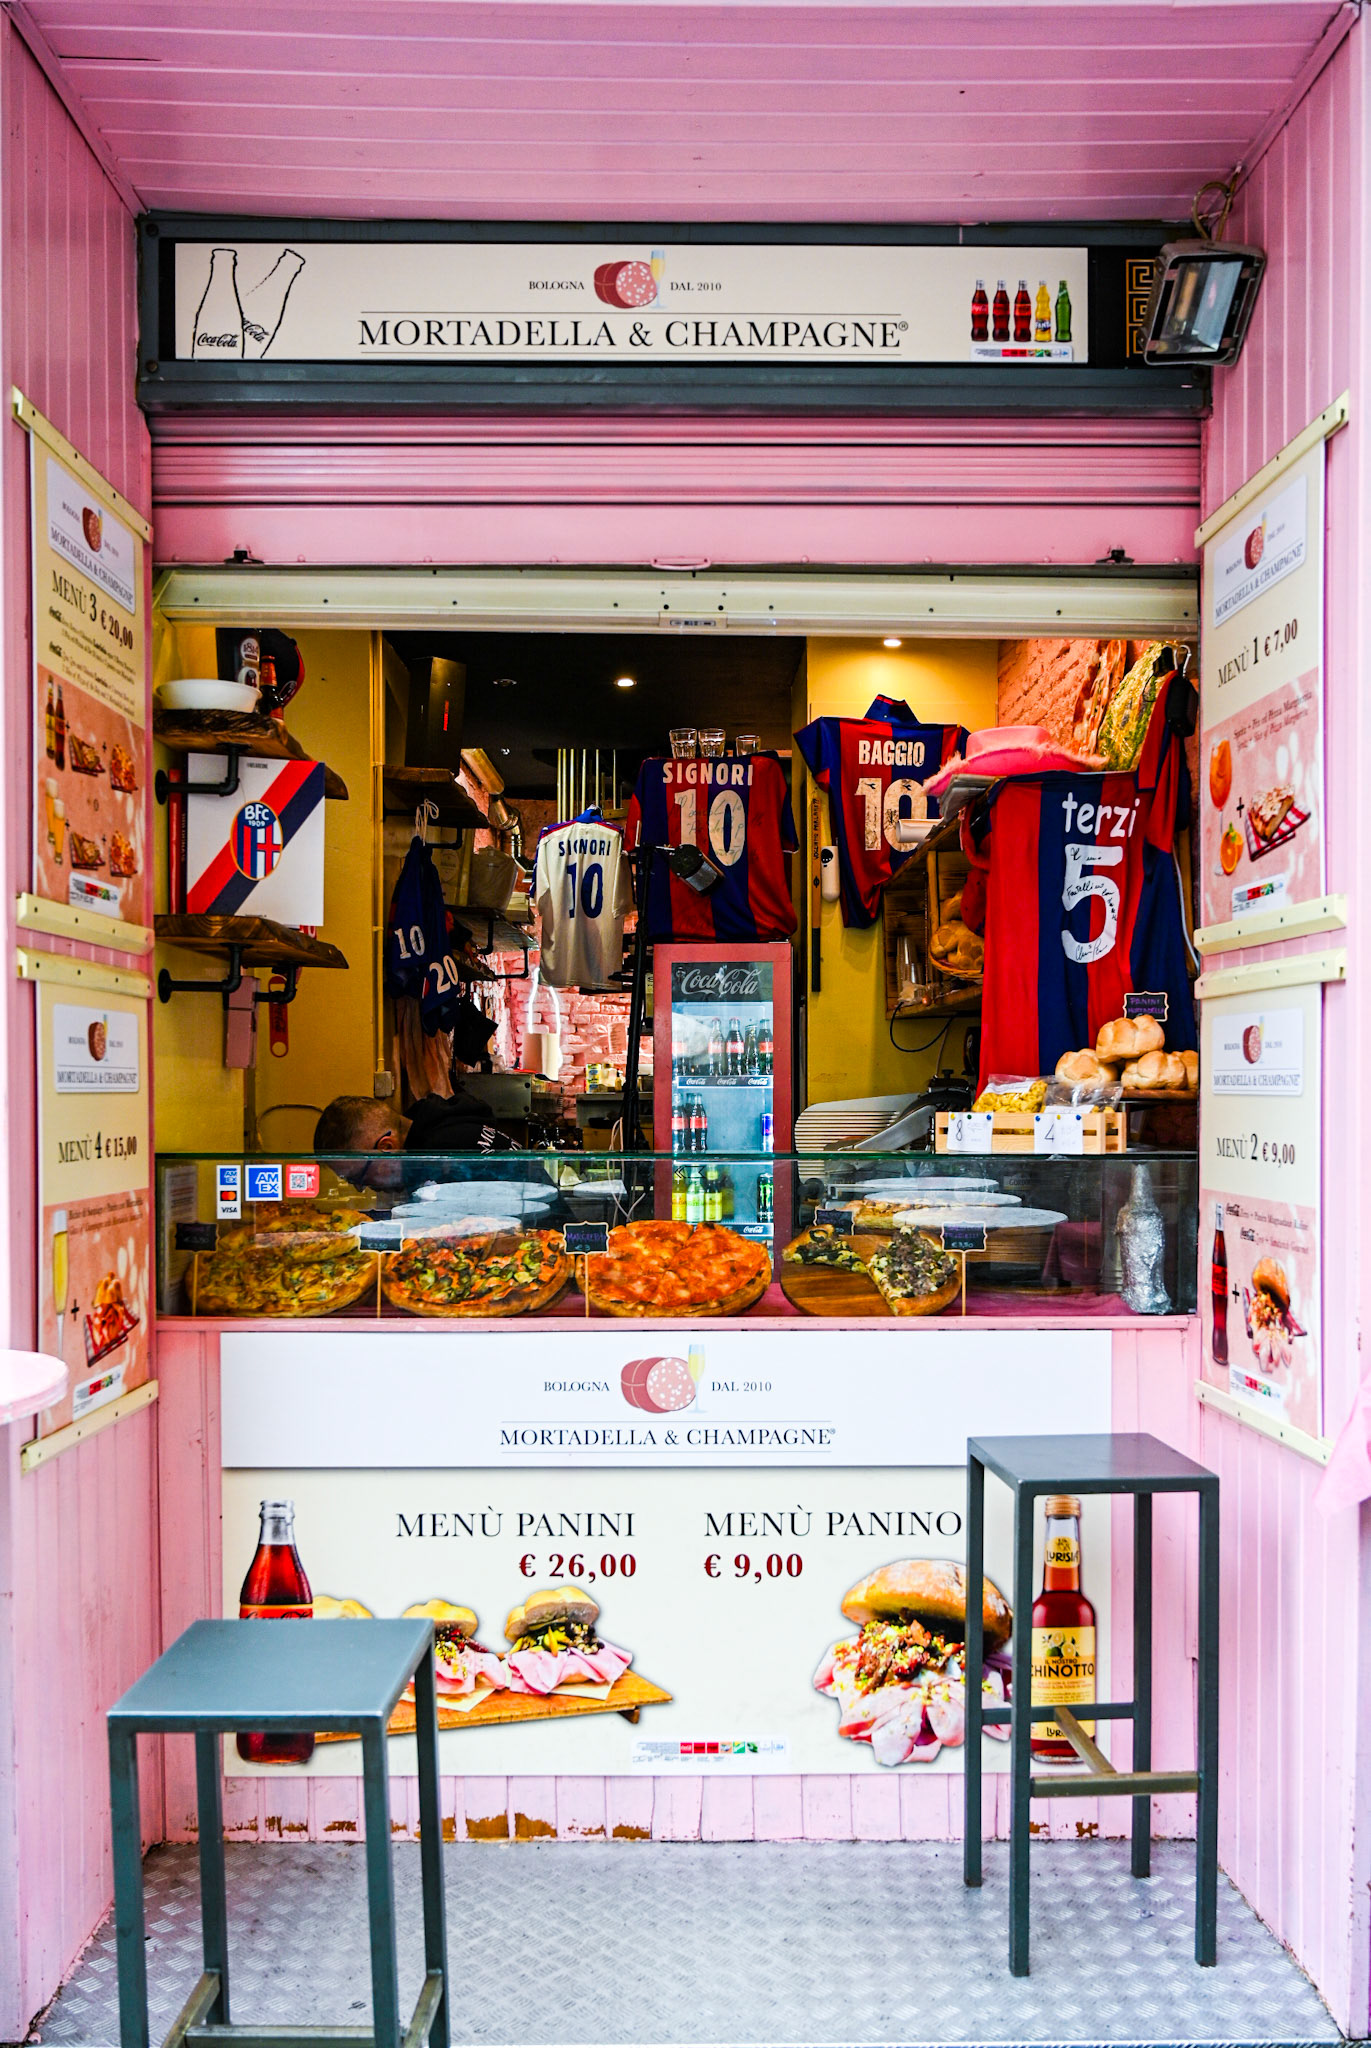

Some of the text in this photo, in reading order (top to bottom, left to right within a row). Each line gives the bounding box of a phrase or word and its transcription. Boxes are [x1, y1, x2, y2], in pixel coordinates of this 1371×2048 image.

[529, 281, 584, 289] BOLOGNA
[670, 282, 722, 291] DAL 2010
[358, 320, 616, 346] MORTADELLA
[630, 321, 652, 346] &
[50, 526, 92, 570] MORTADELLA
[52, 569, 87, 615] MENÙ
[90, 593, 97, 621] 3
[101, 609, 106, 630] €
[108, 615, 133, 650] 20,00
[1215, 583, 1254, 619] MORTADELLA
[1218, 618, 1298, 688] MENÙ 1 € 7,00
[858, 740, 926, 767] BAGGIO
[662, 762, 752, 786] SIGNORI
[245, 804, 270, 820] BFC
[854, 777, 928, 852] 10
[1062, 791, 1140, 838] terzi
[674, 789, 746, 866] 10
[559, 839, 611, 856] SIGNORI
[567, 862, 604, 918] 10
[1061, 843, 1123, 963] 5
[394, 925, 426, 960] 10
[429, 955, 459, 994] 20
[57, 1071, 98, 1084] MORTADELLA
[1214, 1074, 1252, 1086] MORTADELLA
[58, 1131, 137, 1163] MENÙ 4 € 15,00
[1044, 1123, 1055, 1142] 4
[1216, 1133, 1295, 1168] MENÙ 2 € 9,00
[257, 1174, 278, 1182] AM
[260, 1184, 278, 1192] EX
[545, 1382, 609, 1391] BOLOGNA
[712, 1382, 772, 1392] DAL 2010
[500, 1430, 656, 1445] MORTADELLA
[665, 1430, 680, 1445] &
[397, 1506, 634, 1537] MENÙ PANINI
[704, 1505, 962, 1537] MENÙ PANINO
[519, 1554, 636, 1583] € 26,00
[704, 1554, 803, 1584] € 9,00
[1046, 1551, 1080, 1562] LURISIA
